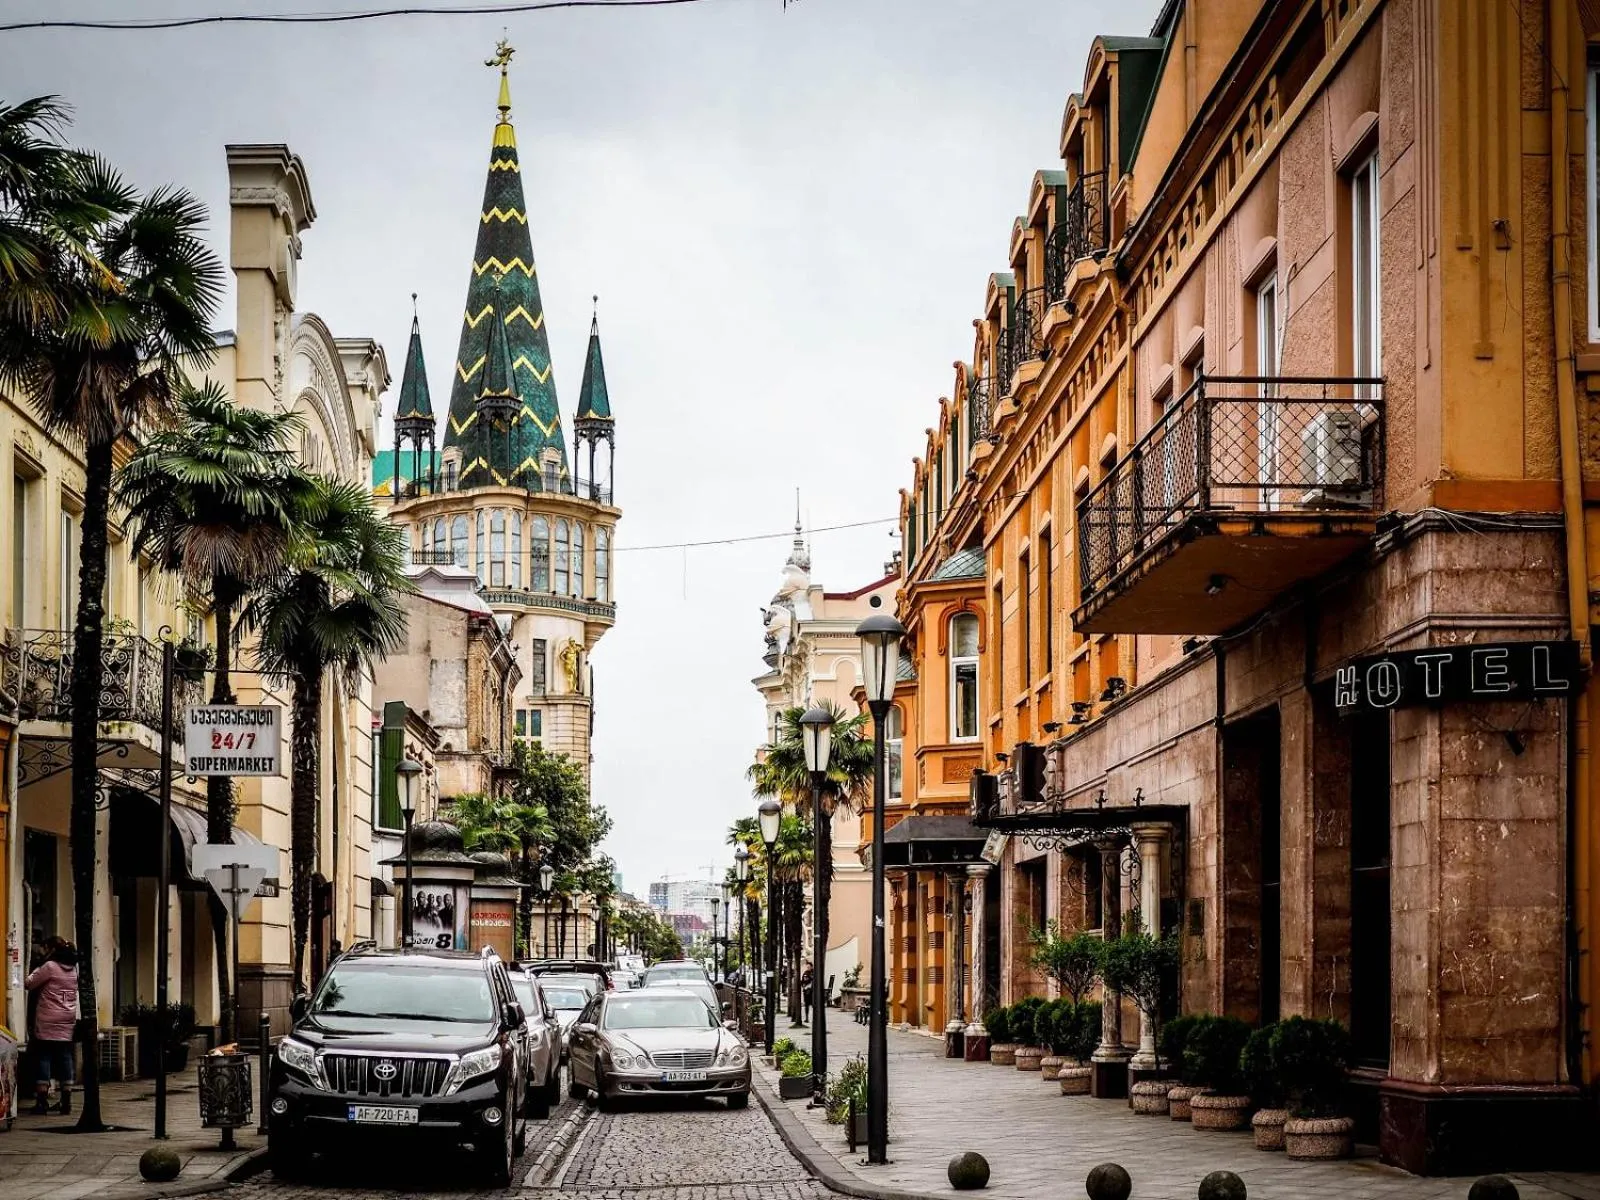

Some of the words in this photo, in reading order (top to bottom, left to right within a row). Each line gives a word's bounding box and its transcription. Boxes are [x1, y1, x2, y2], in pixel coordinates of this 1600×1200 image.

[1335, 646, 1570, 708] HOTEL
[211, 732, 256, 750] 24/7
[190, 757, 274, 772] SUPERMARKET
[435, 933, 452, 949] 8
